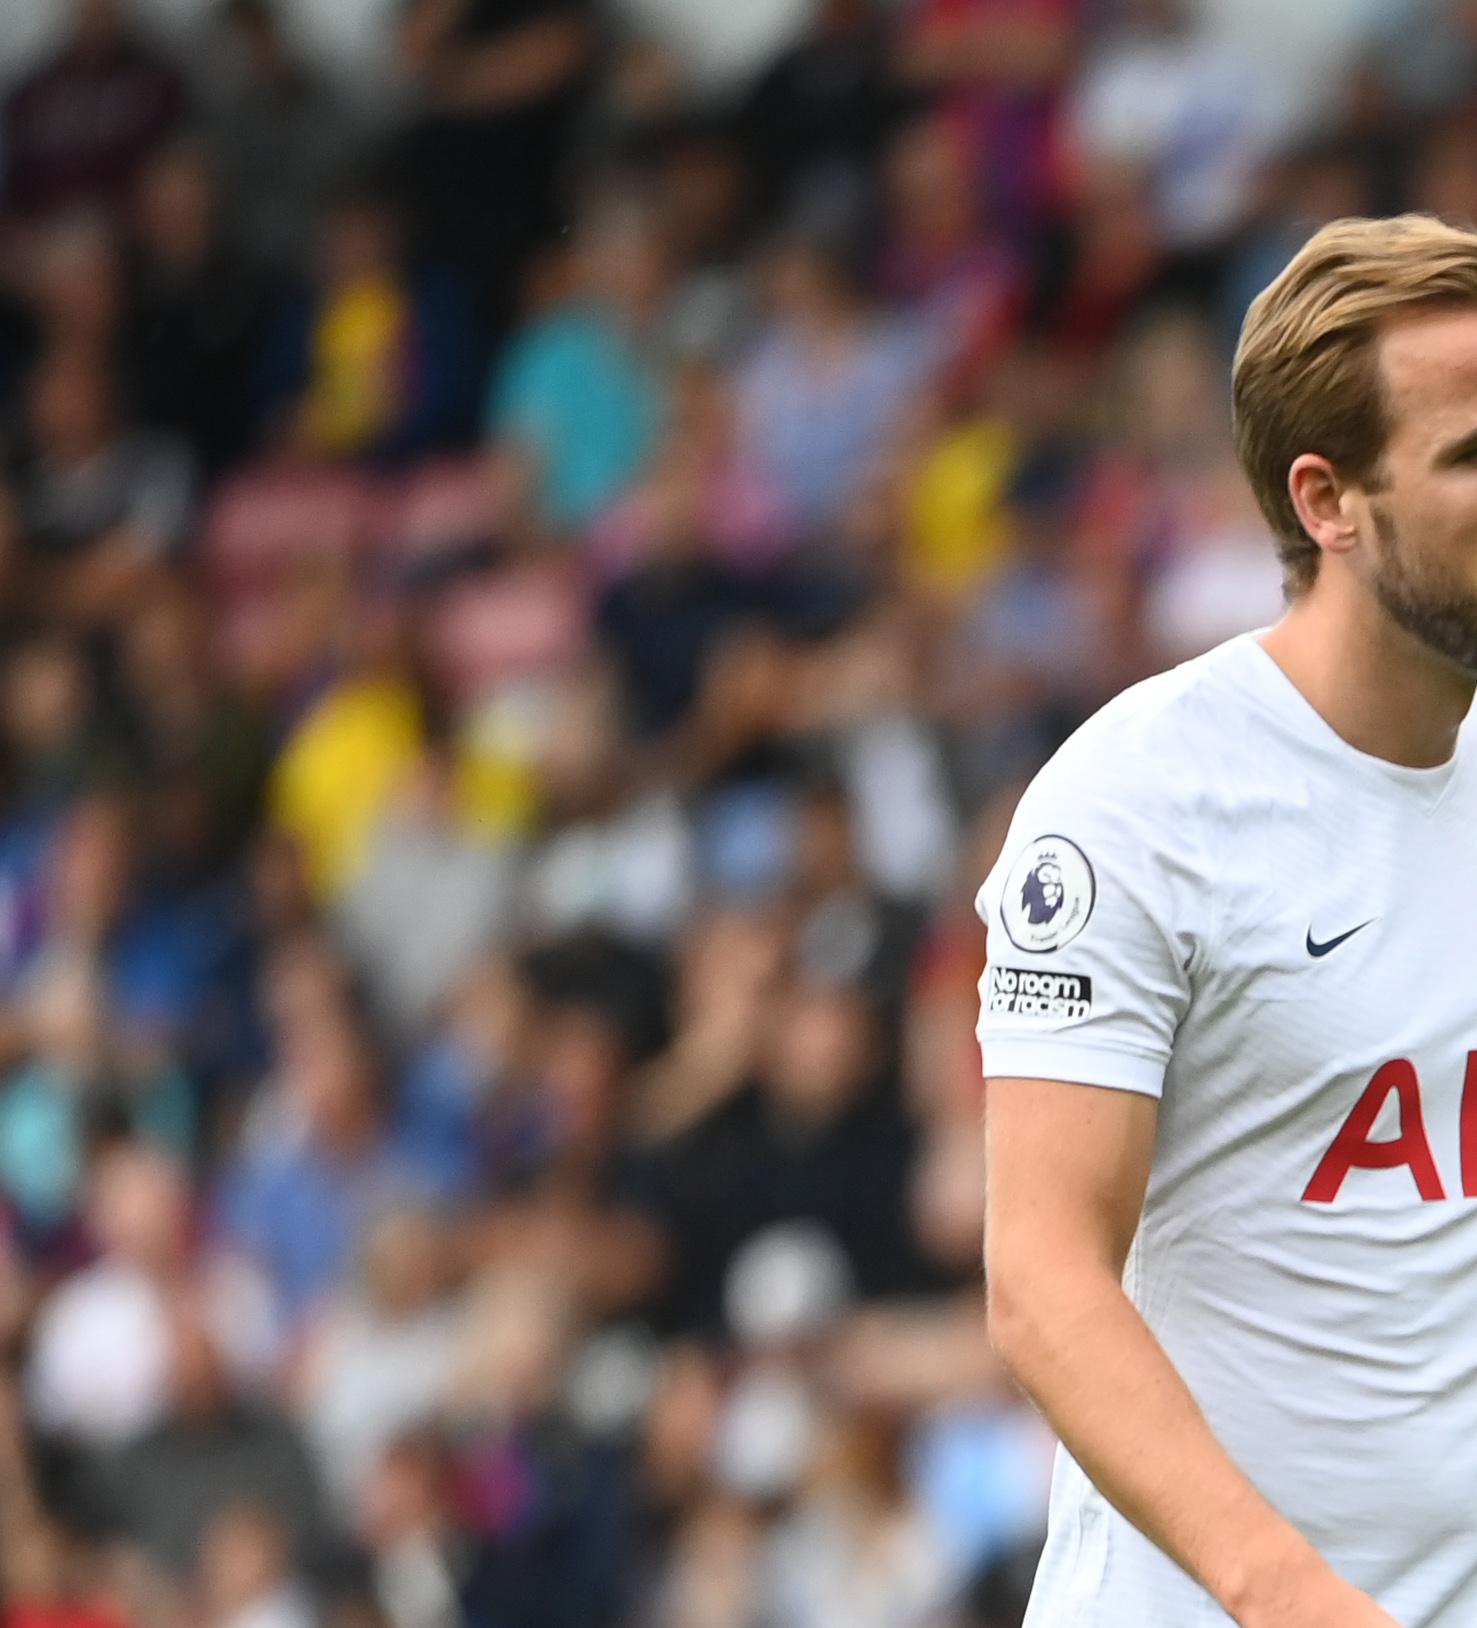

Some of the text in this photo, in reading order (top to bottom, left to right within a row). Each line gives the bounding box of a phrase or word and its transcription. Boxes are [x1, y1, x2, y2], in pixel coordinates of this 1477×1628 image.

[990, 966, 1081, 1000] No room
[1013, 994, 1092, 1021] racism
